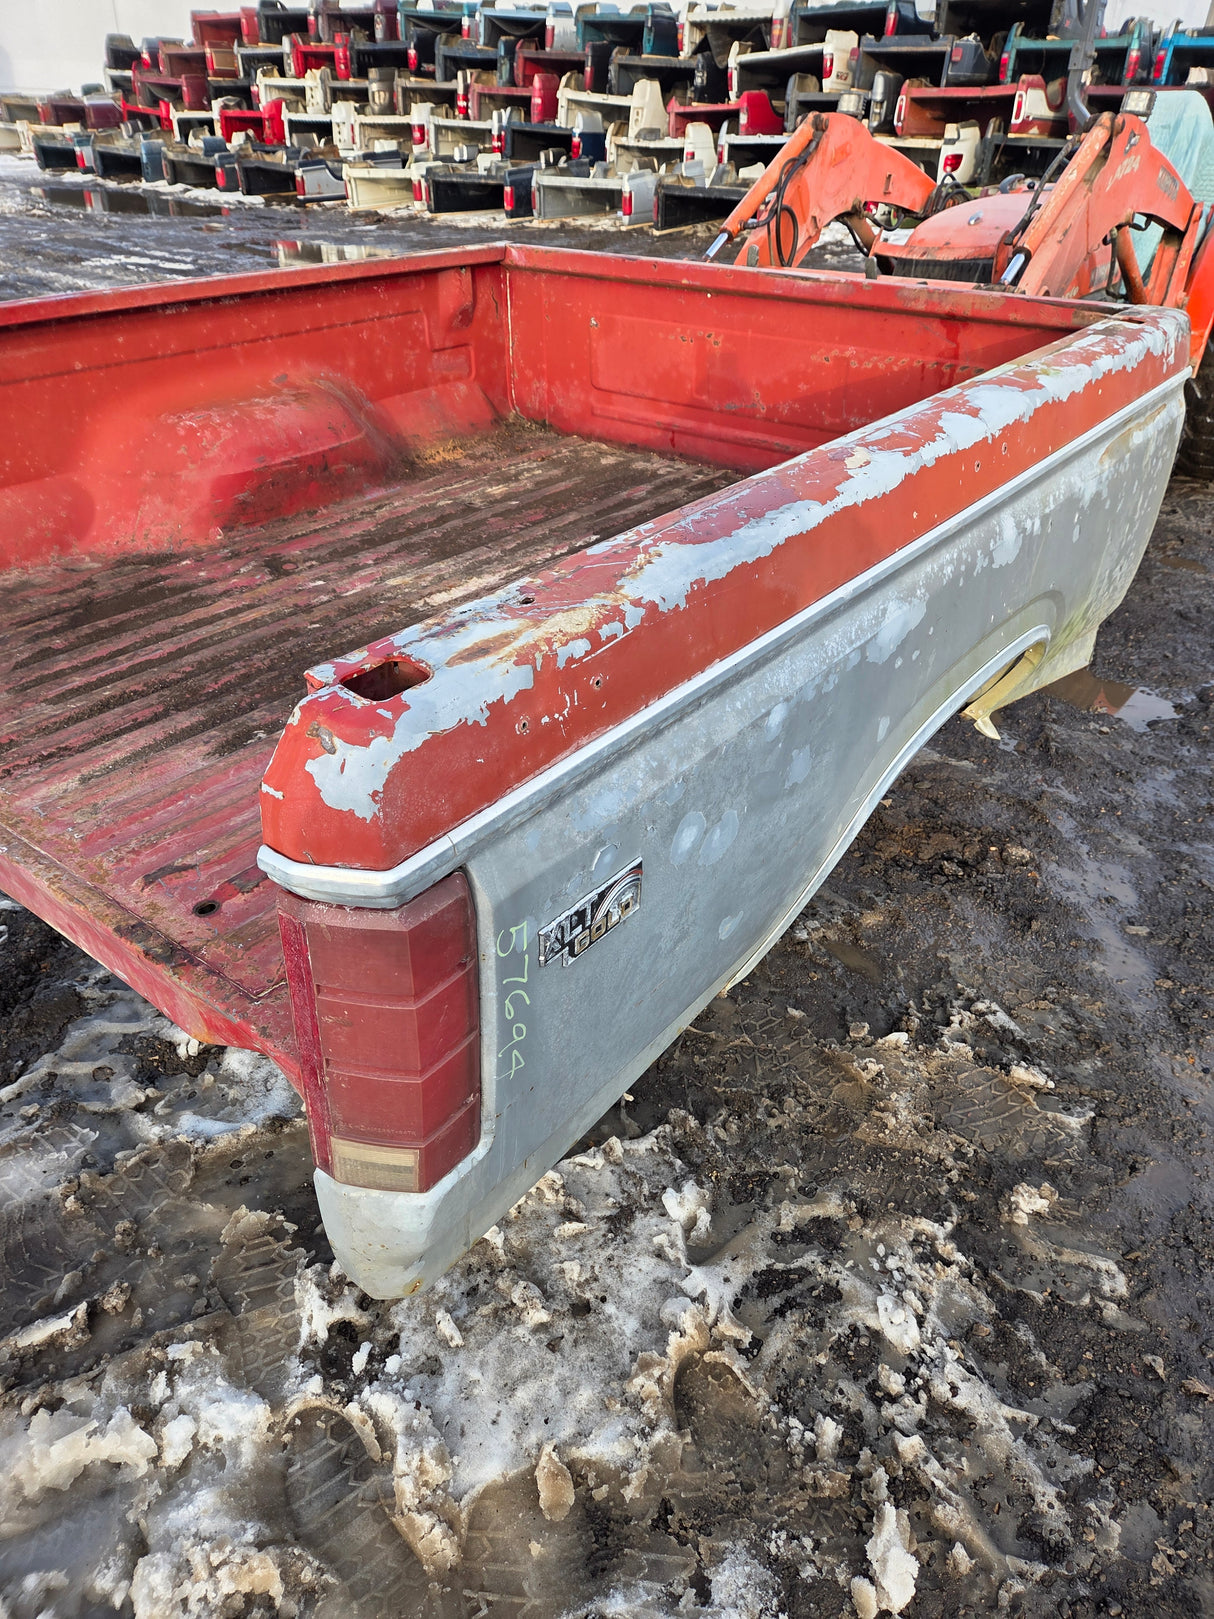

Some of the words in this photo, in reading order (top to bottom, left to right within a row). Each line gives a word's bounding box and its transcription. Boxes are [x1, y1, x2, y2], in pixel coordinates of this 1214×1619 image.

[544, 893, 600, 959] XLT
[574, 894, 635, 956] GOLD
[496, 920, 531, 1081] 57694
